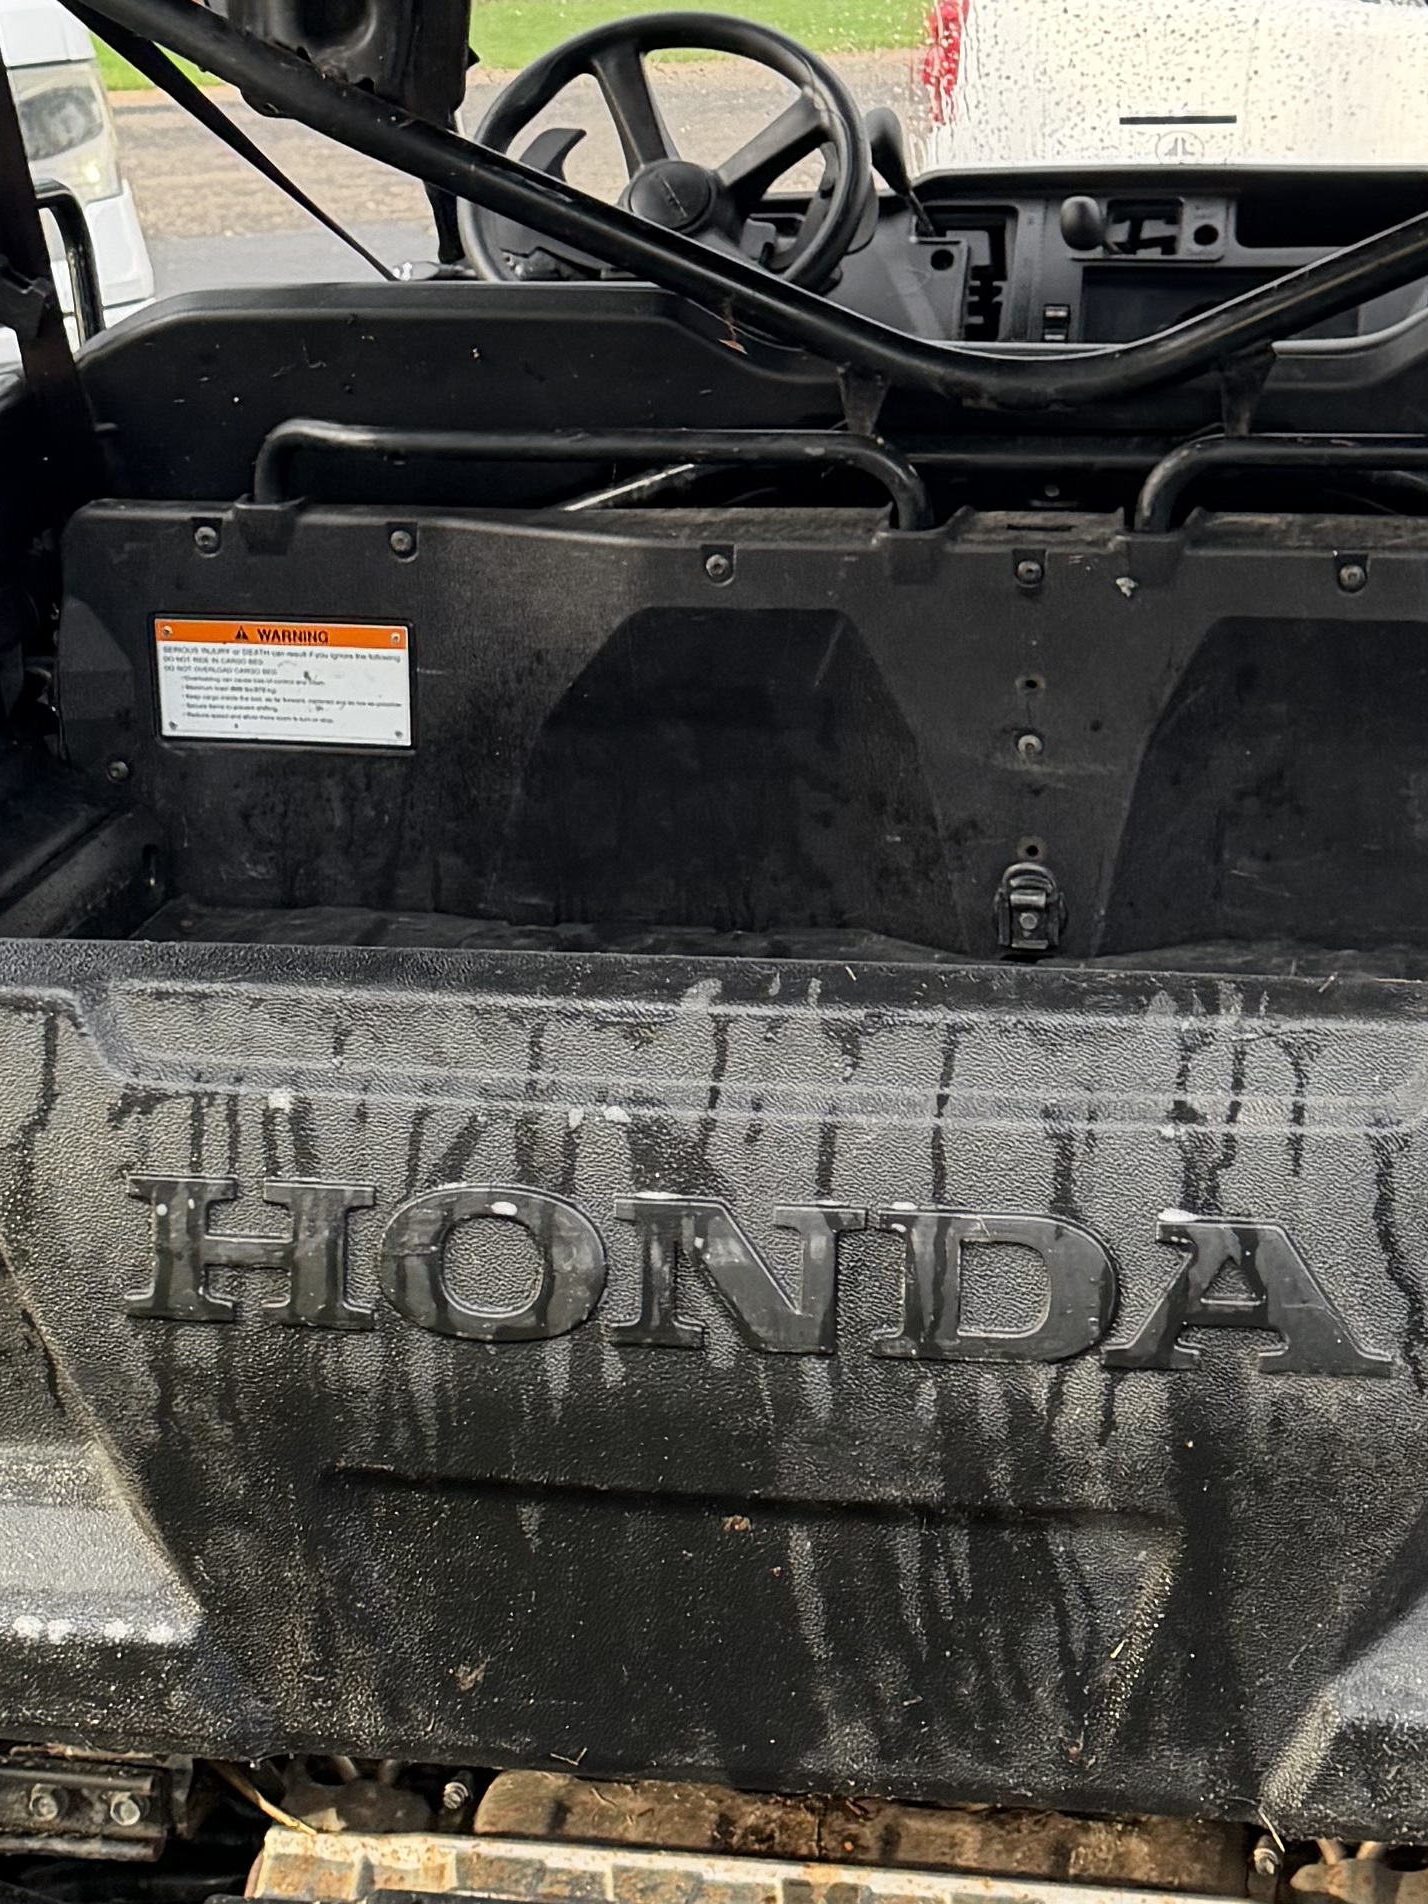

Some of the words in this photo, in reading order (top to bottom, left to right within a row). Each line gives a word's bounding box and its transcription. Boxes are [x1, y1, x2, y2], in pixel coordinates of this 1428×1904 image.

[256, 628, 329, 644] WARNING
[242, 648, 270, 656] DEATH
[124, 1174, 1392, 1378] HONDA
